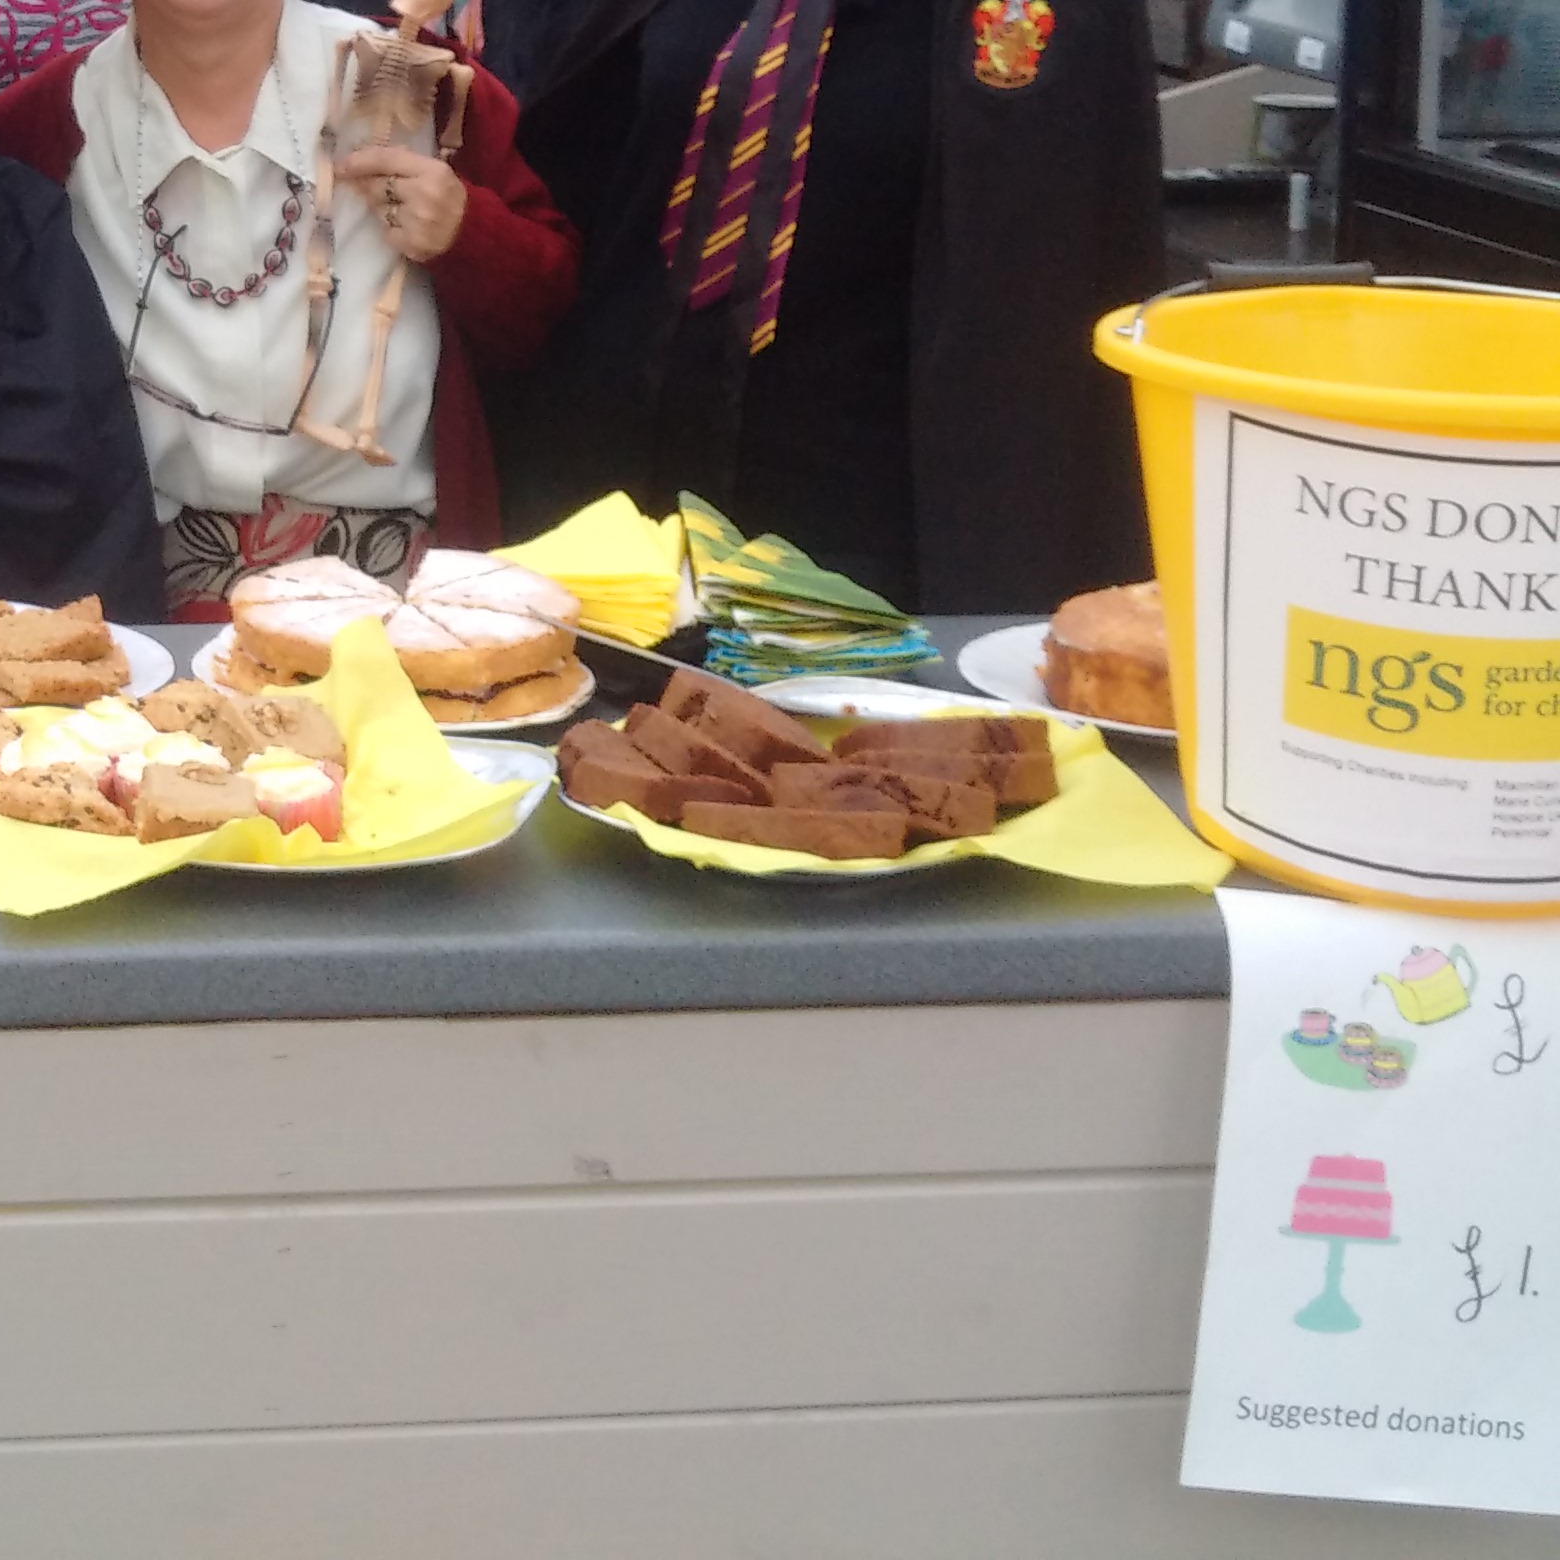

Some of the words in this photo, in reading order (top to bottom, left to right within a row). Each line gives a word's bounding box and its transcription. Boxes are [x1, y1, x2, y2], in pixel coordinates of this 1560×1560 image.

[1295, 474, 1408, 533] NGS
[1425, 497, 1560, 544] DON
[1344, 551, 1560, 612] THANK
[1305, 639, 1466, 734] ngs
[1483, 693, 1527, 717] for
[1236, 1396, 1380, 1430] Suggested
[1387, 1407, 1526, 1441] donations
